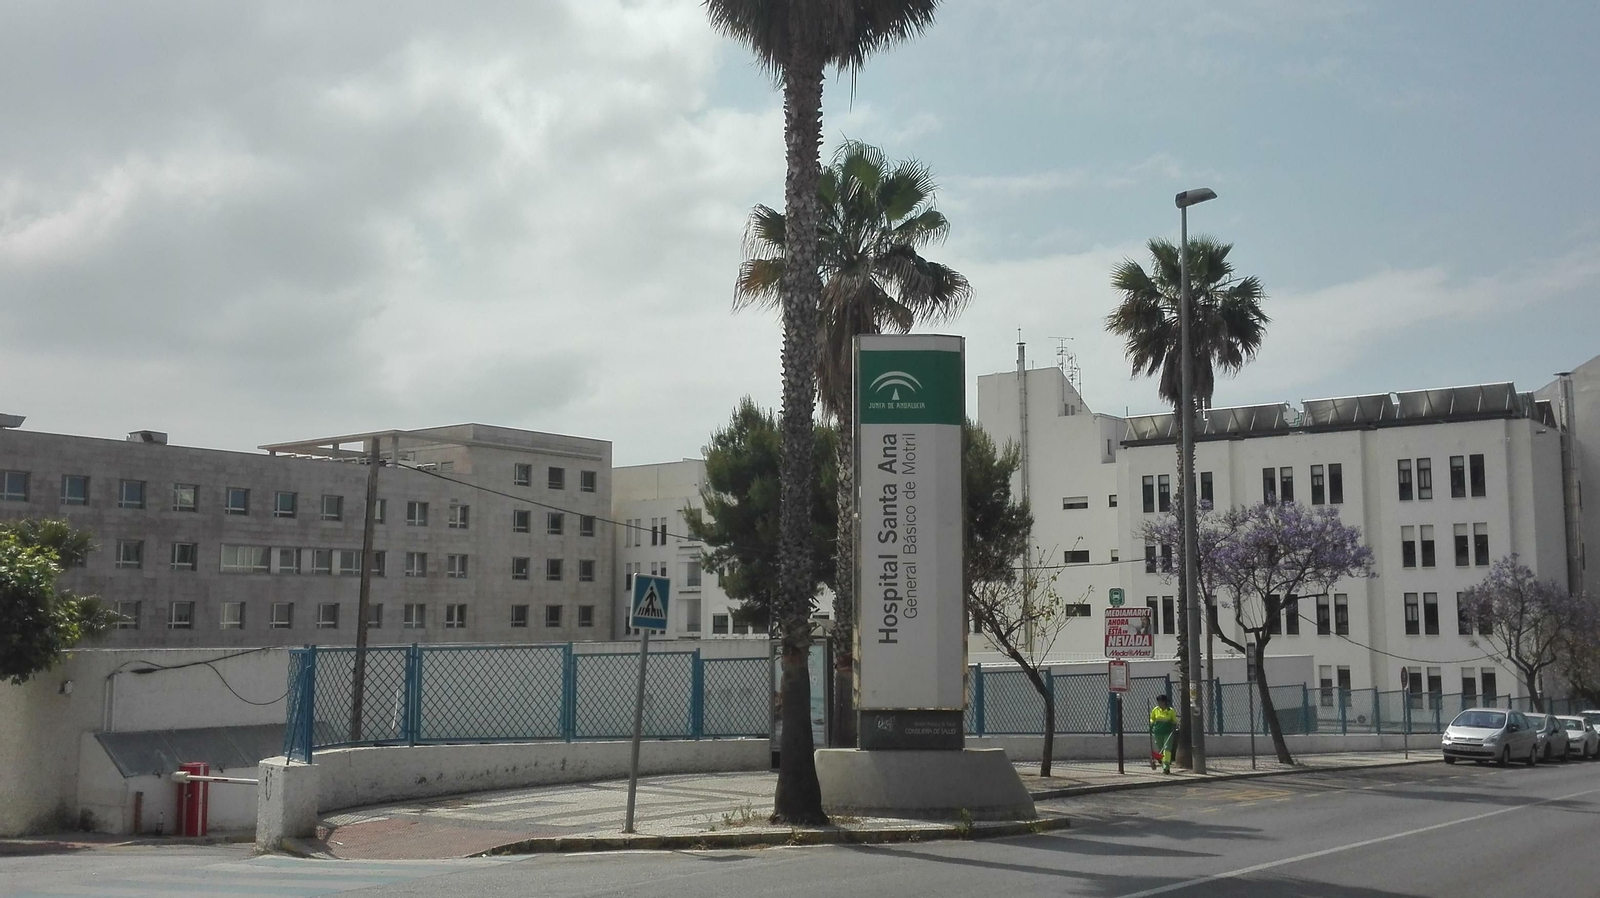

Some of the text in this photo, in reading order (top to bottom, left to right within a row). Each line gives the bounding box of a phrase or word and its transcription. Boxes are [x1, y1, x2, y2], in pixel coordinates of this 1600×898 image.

[902, 433, 918, 619] General Básico de Motril
[878, 433, 903, 644] Hospital Santa Ana
[1105, 608, 1150, 616] MEDIAMARKT
[1108, 635, 1149, 647] NEVADA
[1109, 649, 1151, 657] Media Markt
